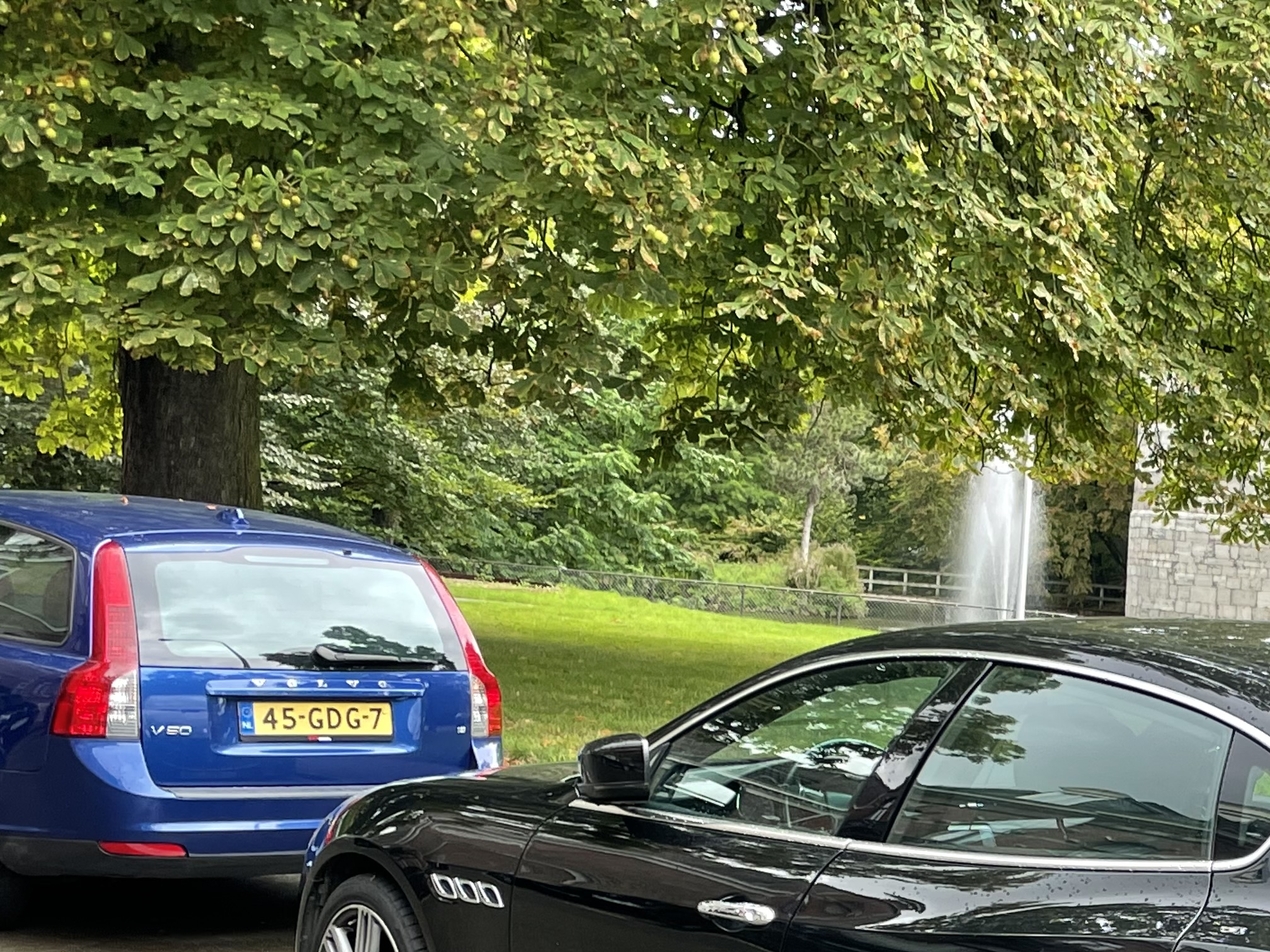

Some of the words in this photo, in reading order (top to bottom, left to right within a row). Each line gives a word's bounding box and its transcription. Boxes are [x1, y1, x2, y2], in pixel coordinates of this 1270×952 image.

[241, 722, 254, 730] NL
[262, 707, 383, 730] 45-GDG-7
[149, 724, 193, 737] V50
